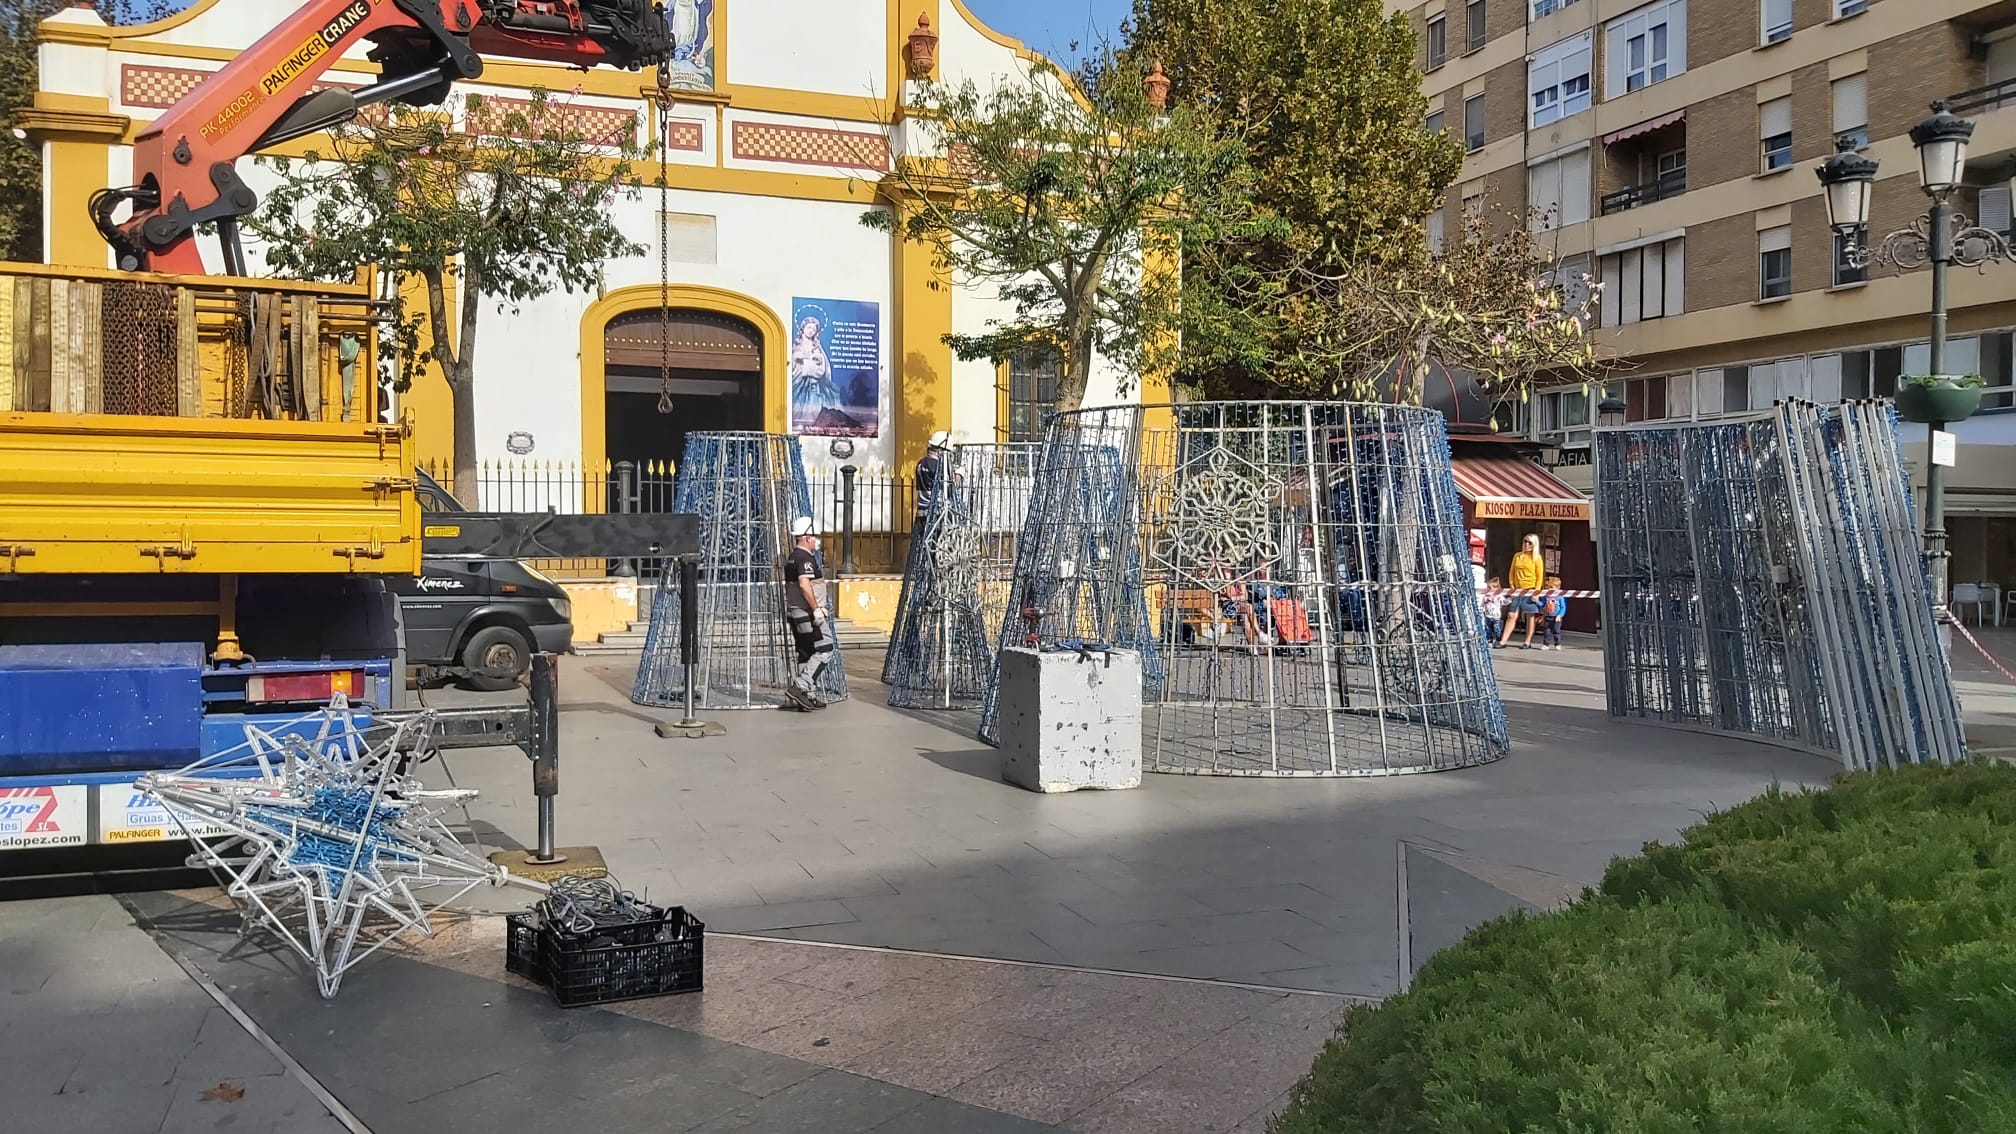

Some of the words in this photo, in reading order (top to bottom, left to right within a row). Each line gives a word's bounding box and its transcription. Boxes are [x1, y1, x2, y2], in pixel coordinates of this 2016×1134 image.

[262, 37, 326, 95] PALFINGER
[323, 1, 368, 43] CRANE
[199, 120, 218, 139] PK
[218, 90, 256, 125] 44002
[219, 97, 266, 135] Performance
[1485, 502, 1515, 515] KIOSCO
[1519, 503, 1546, 517] PLAZA
[1549, 504, 1580, 518] IGLESIA
[416, 575, 465, 592] Ximenez
[130, 814, 164, 824] Gruas
[0, 834, 81, 848] slopez.com
[109, 828, 162, 840] PALFINGER
